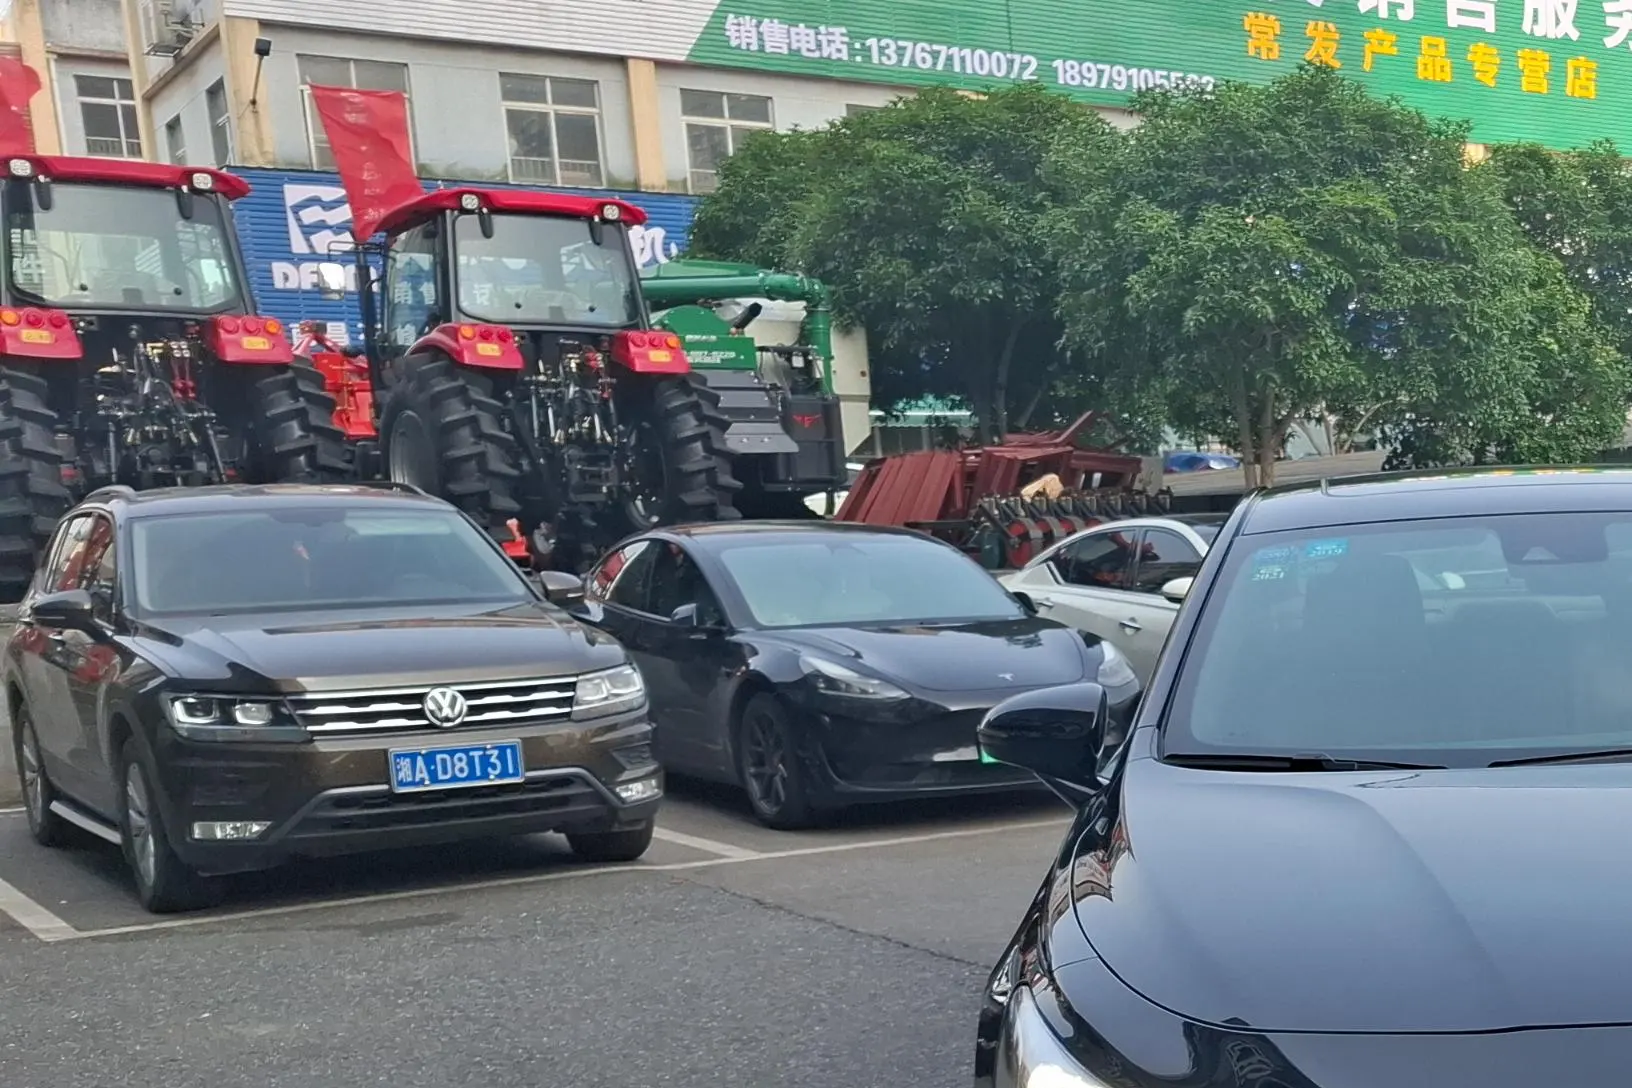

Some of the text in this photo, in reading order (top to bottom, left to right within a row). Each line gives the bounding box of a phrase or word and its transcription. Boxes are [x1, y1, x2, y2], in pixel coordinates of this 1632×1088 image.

[1243, 11, 1597, 99] 常发产品专营店
